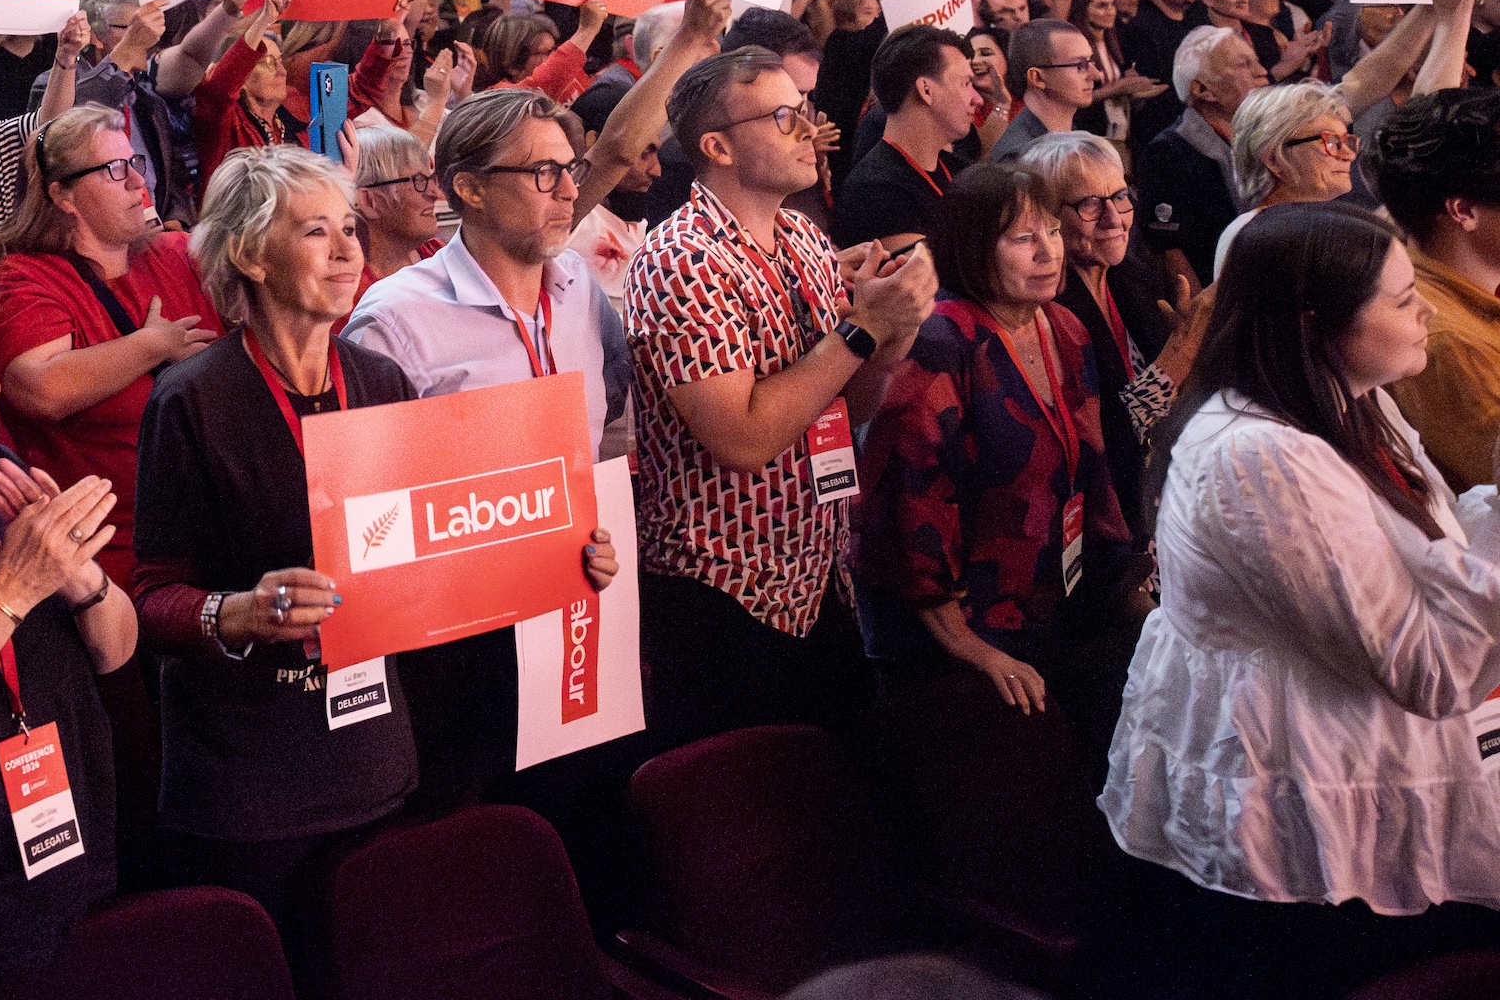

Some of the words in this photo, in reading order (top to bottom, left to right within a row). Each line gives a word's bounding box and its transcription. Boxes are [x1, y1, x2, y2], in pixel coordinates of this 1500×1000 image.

[426, 486, 555, 542] Labour
[337, 690, 379, 711] DELEGATE
[31, 829, 72, 857] DELEGATE
